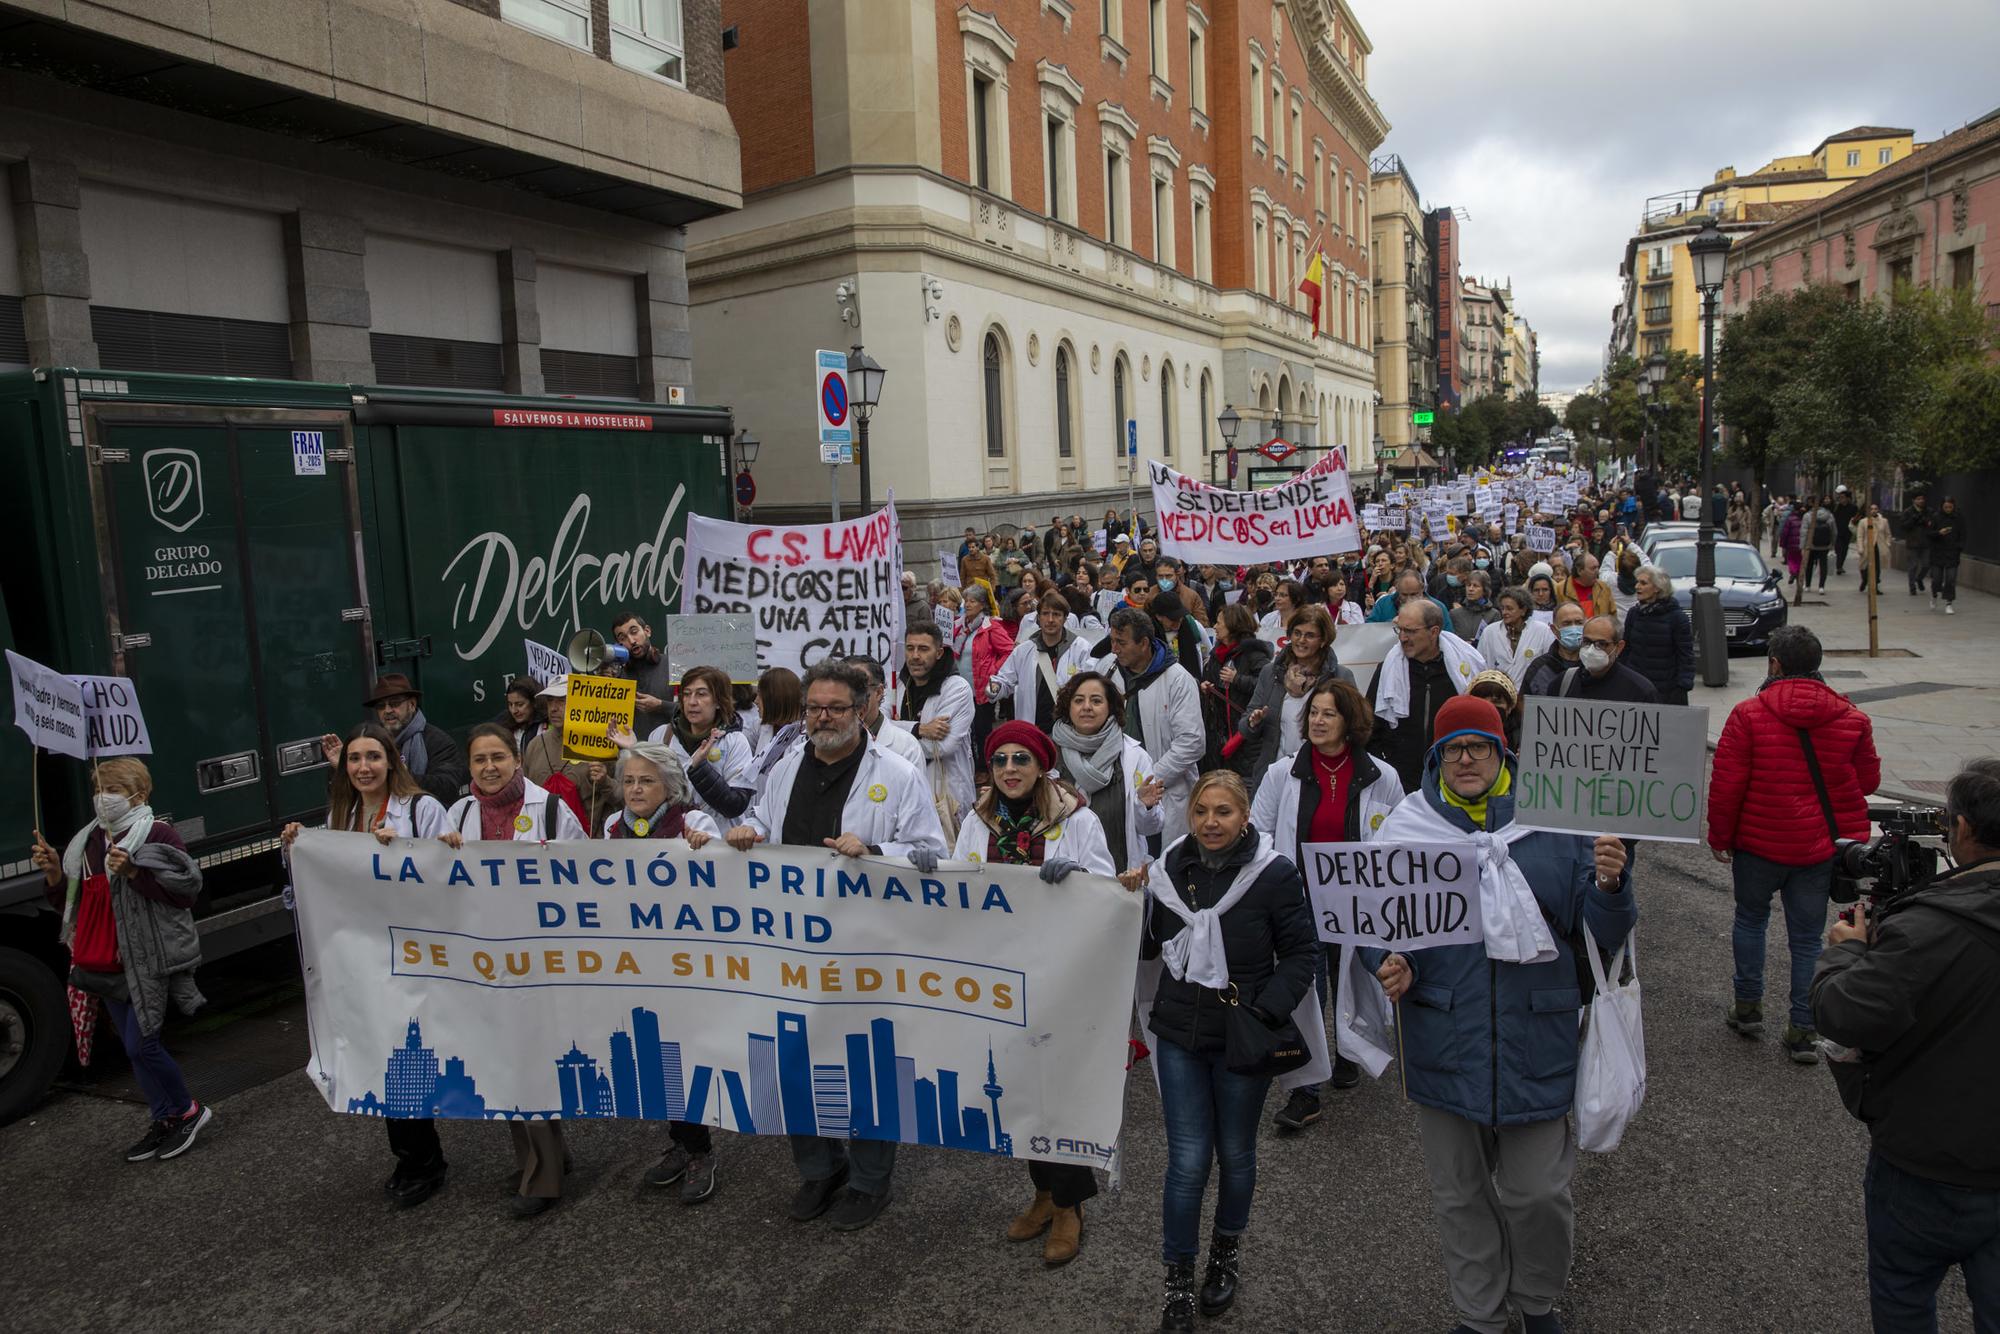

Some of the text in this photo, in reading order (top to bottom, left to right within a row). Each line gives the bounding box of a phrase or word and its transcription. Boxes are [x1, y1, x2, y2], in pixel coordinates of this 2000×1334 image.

[503, 413, 646, 428] SALVEMOS LA HOSTELERÍA
[293, 433, 322, 454] FRAX
[1151, 464, 1175, 487] LA
[1176, 492, 1206, 511] SE
[1210, 477, 1329, 513] DEFIENDE
[1270, 521, 1291, 536] en
[1294, 498, 1353, 539] LUCHA
[155, 545, 210, 561] GRUPO
[747, 528, 811, 566] C.S.
[146, 561, 222, 580] DELGADO
[441, 482, 687, 661] Delgado
[836, 567, 868, 600] EN
[759, 605, 810, 632] UNA
[571, 680, 631, 701] Privatizar
[41, 714, 55, 731] seis
[56, 720, 76, 738] manos.
[570, 707, 629, 725] es robarnos
[1537, 705, 1660, 746] NINGÚN
[568, 730, 578, 745] lo
[1535, 741, 1659, 773] PACIENTE
[1518, 771, 1697, 822] SIN MÉDICO
[372, 852, 1014, 914] LA ATENCIÓN PRIMARIA
[1315, 849, 1462, 888] DERECHO
[537, 901, 833, 944] DE MADRID
[1322, 911, 1345, 934] a
[1381, 892, 1469, 942] SALUD.
[402, 940, 1014, 1010] SE QUEDA SIN MÉDICOS
